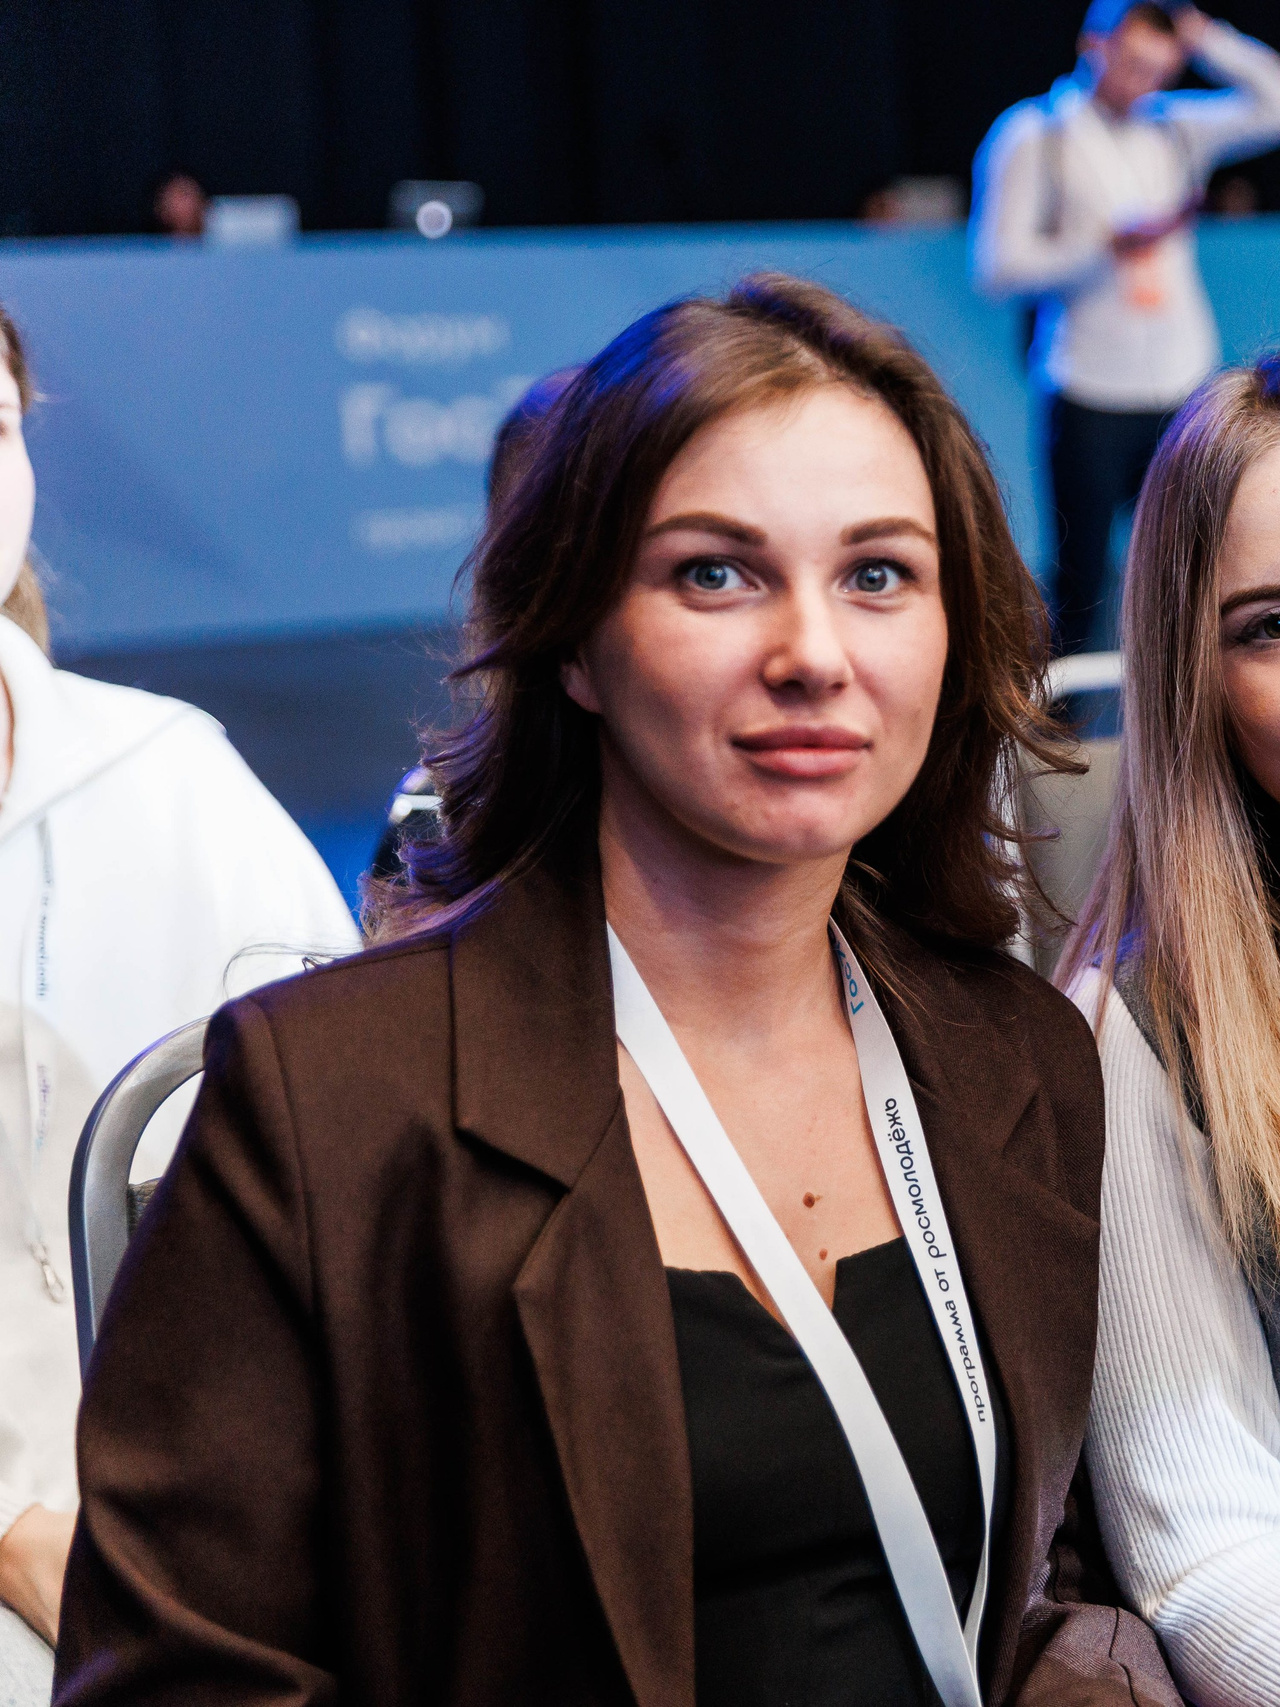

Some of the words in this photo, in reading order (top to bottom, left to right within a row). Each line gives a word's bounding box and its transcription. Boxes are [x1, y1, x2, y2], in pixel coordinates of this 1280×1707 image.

[885, 1098, 947, 1259] росмолодёжь
[934, 1268, 950, 1292] от
[945, 1300, 986, 1422] программа
